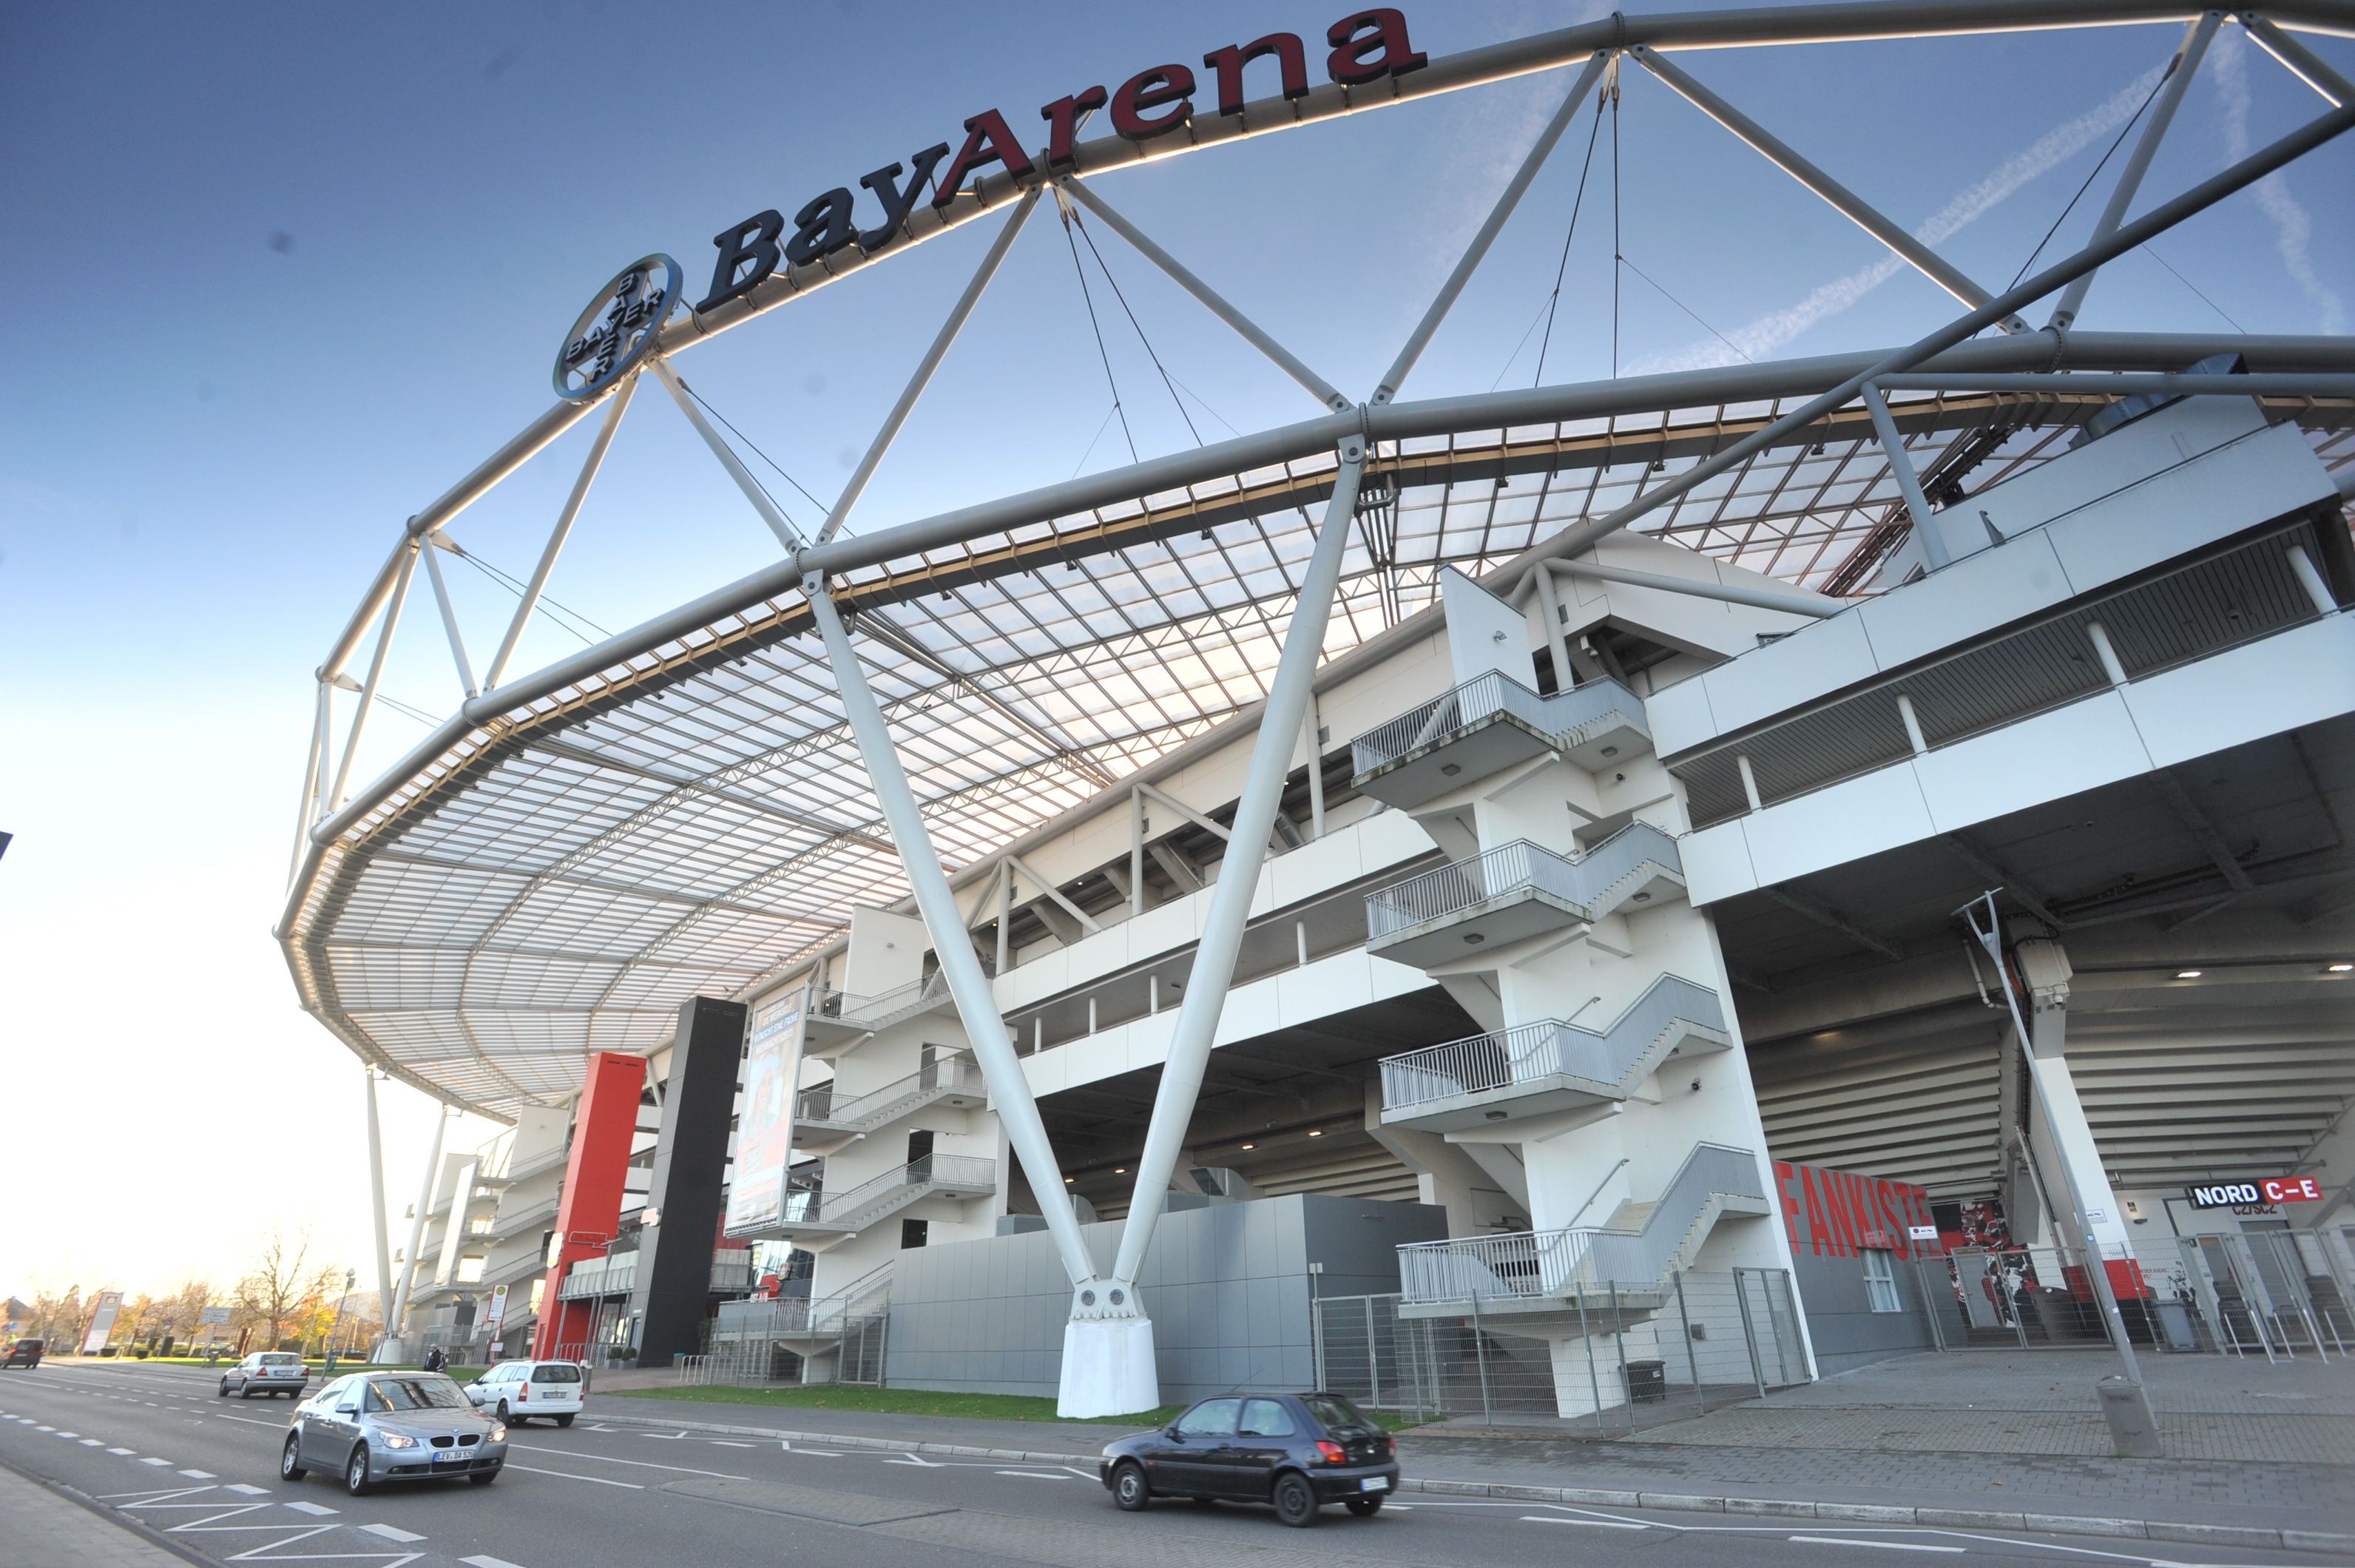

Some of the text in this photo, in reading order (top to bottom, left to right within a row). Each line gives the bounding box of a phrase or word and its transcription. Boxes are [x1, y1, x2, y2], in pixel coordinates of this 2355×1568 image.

[696, 7, 1427, 313] BayArena
[565, 287, 666, 364] BAYER
[589, 272, 638, 383] BAYER
[1774, 1161, 1947, 1263] FANKISTE
[2194, 1183, 2259, 1206] NORD
